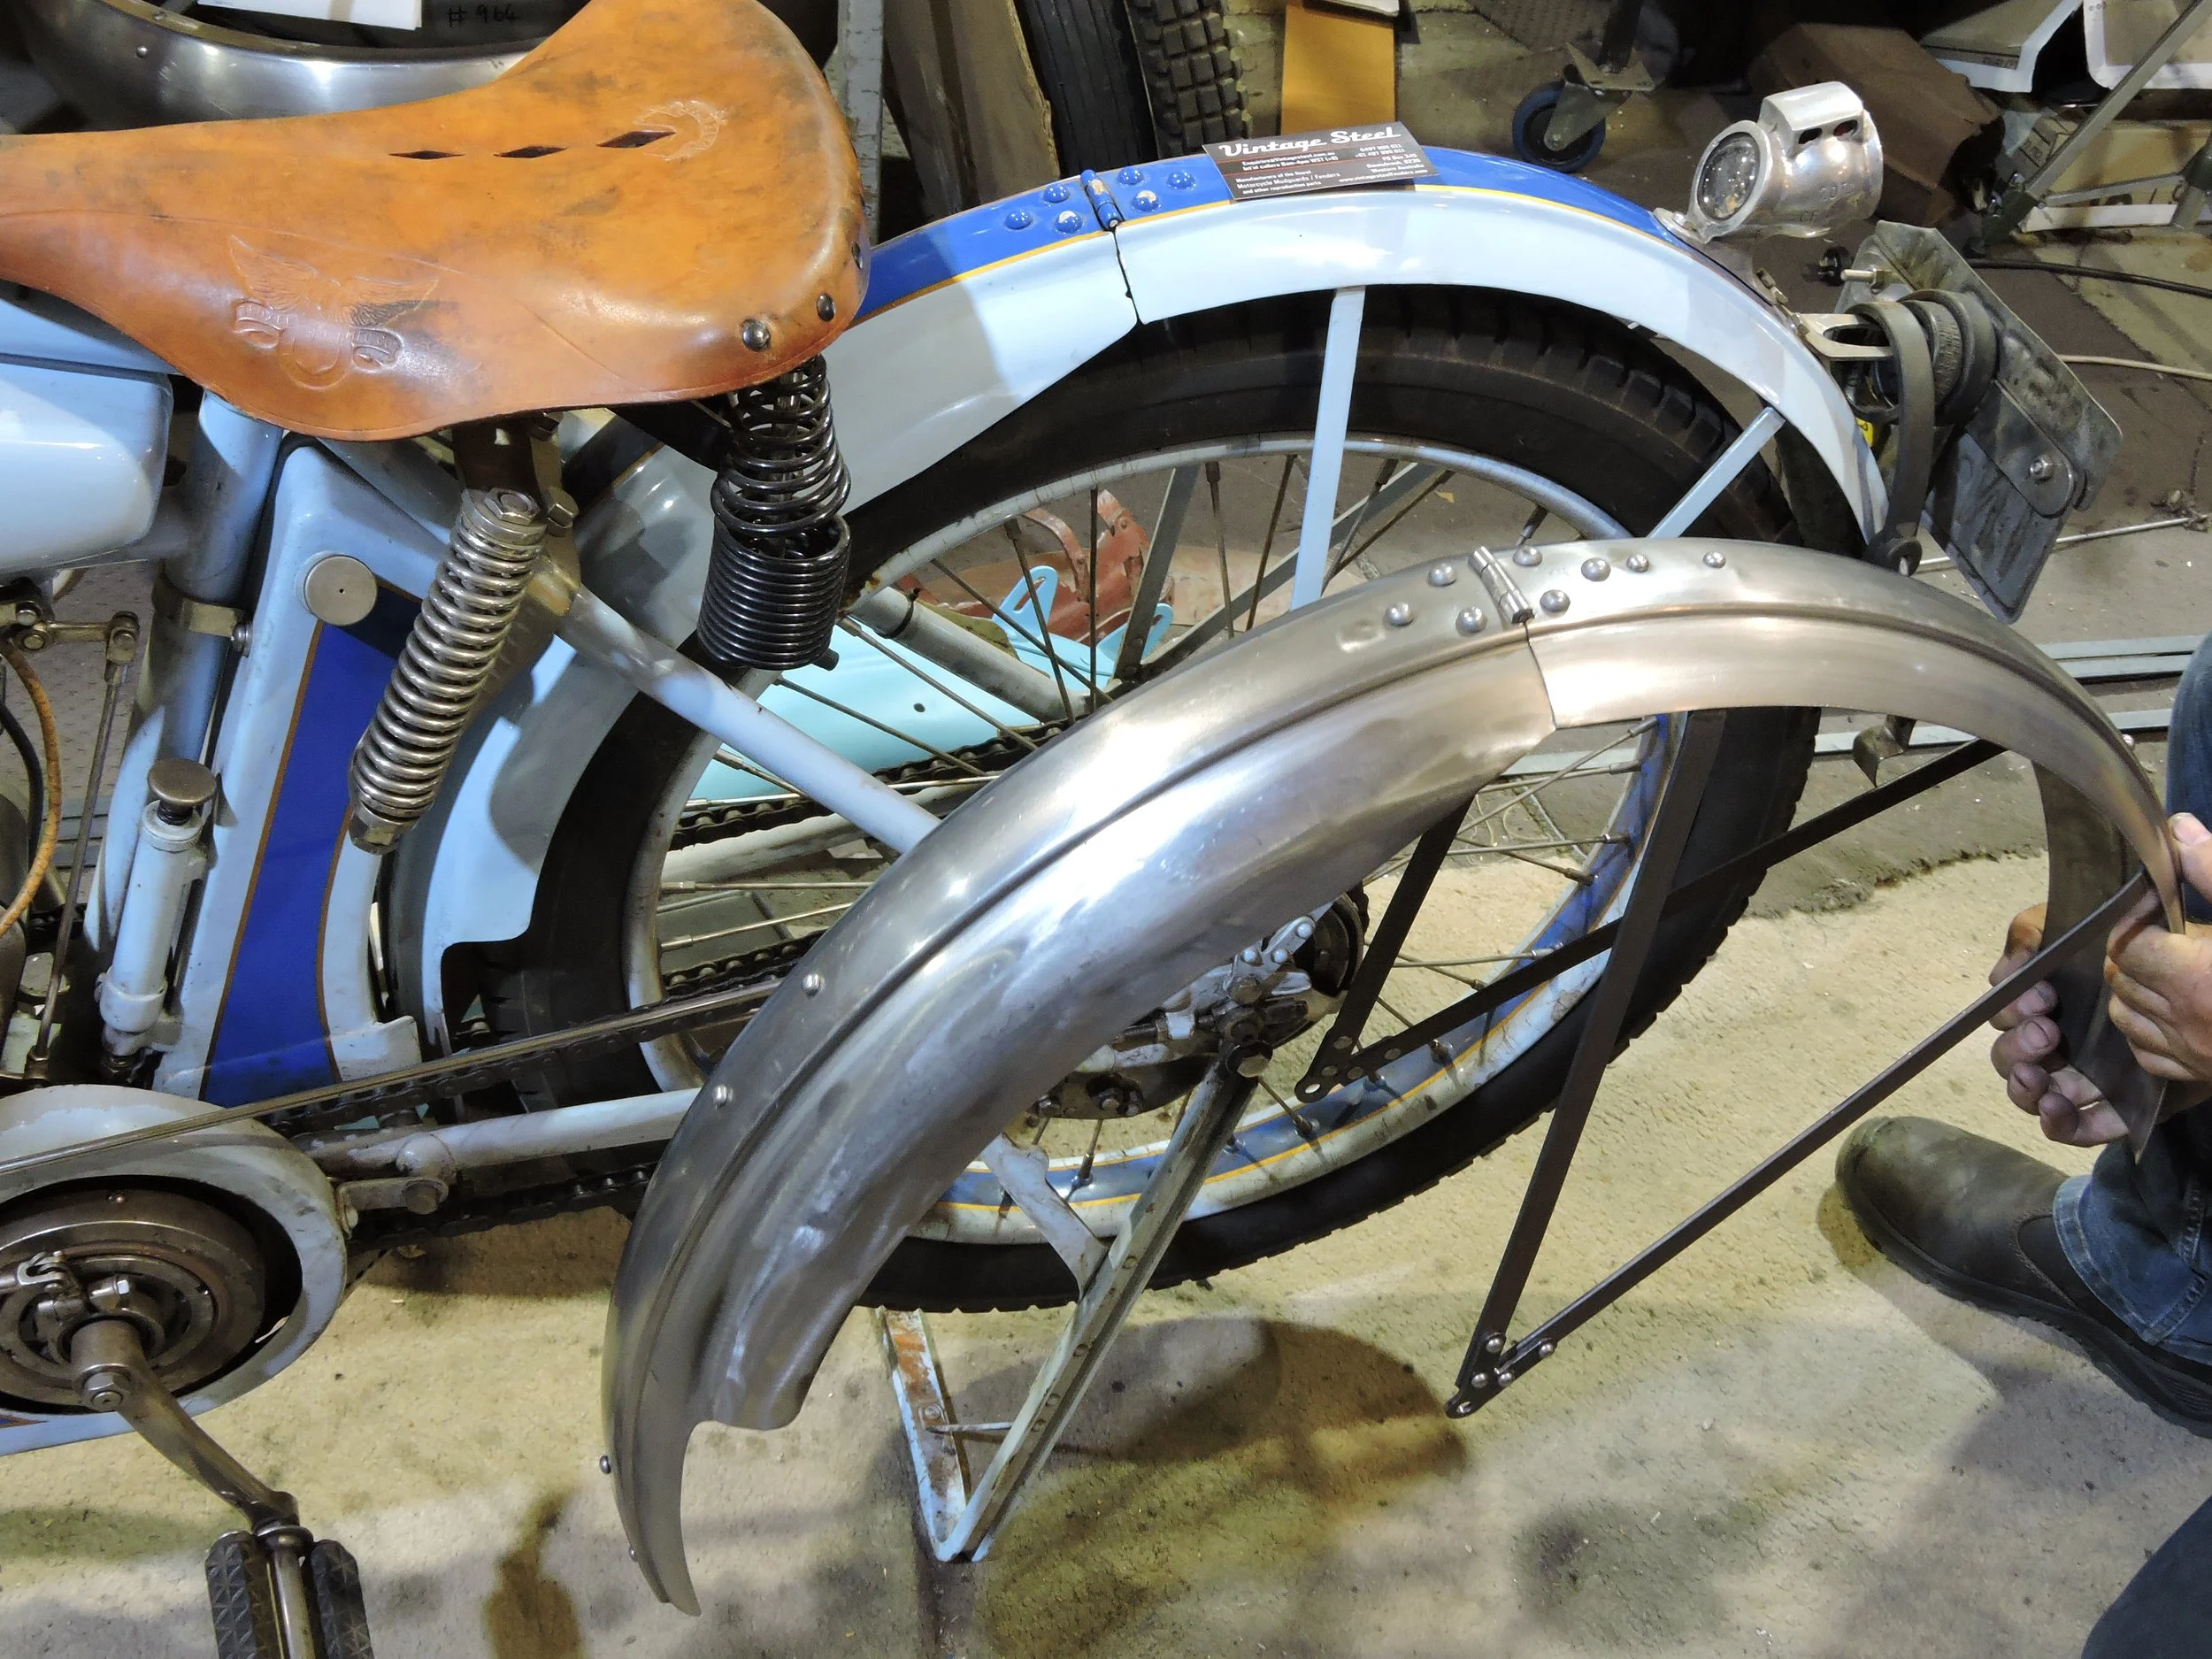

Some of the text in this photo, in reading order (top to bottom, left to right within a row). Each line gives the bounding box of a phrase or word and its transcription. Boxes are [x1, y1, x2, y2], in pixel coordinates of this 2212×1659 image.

[1218, 127, 1402, 157] Vintage Steel
[1237, 180, 1273, 189] Motorcycle
[1270, 182, 1306, 191] reproduction
